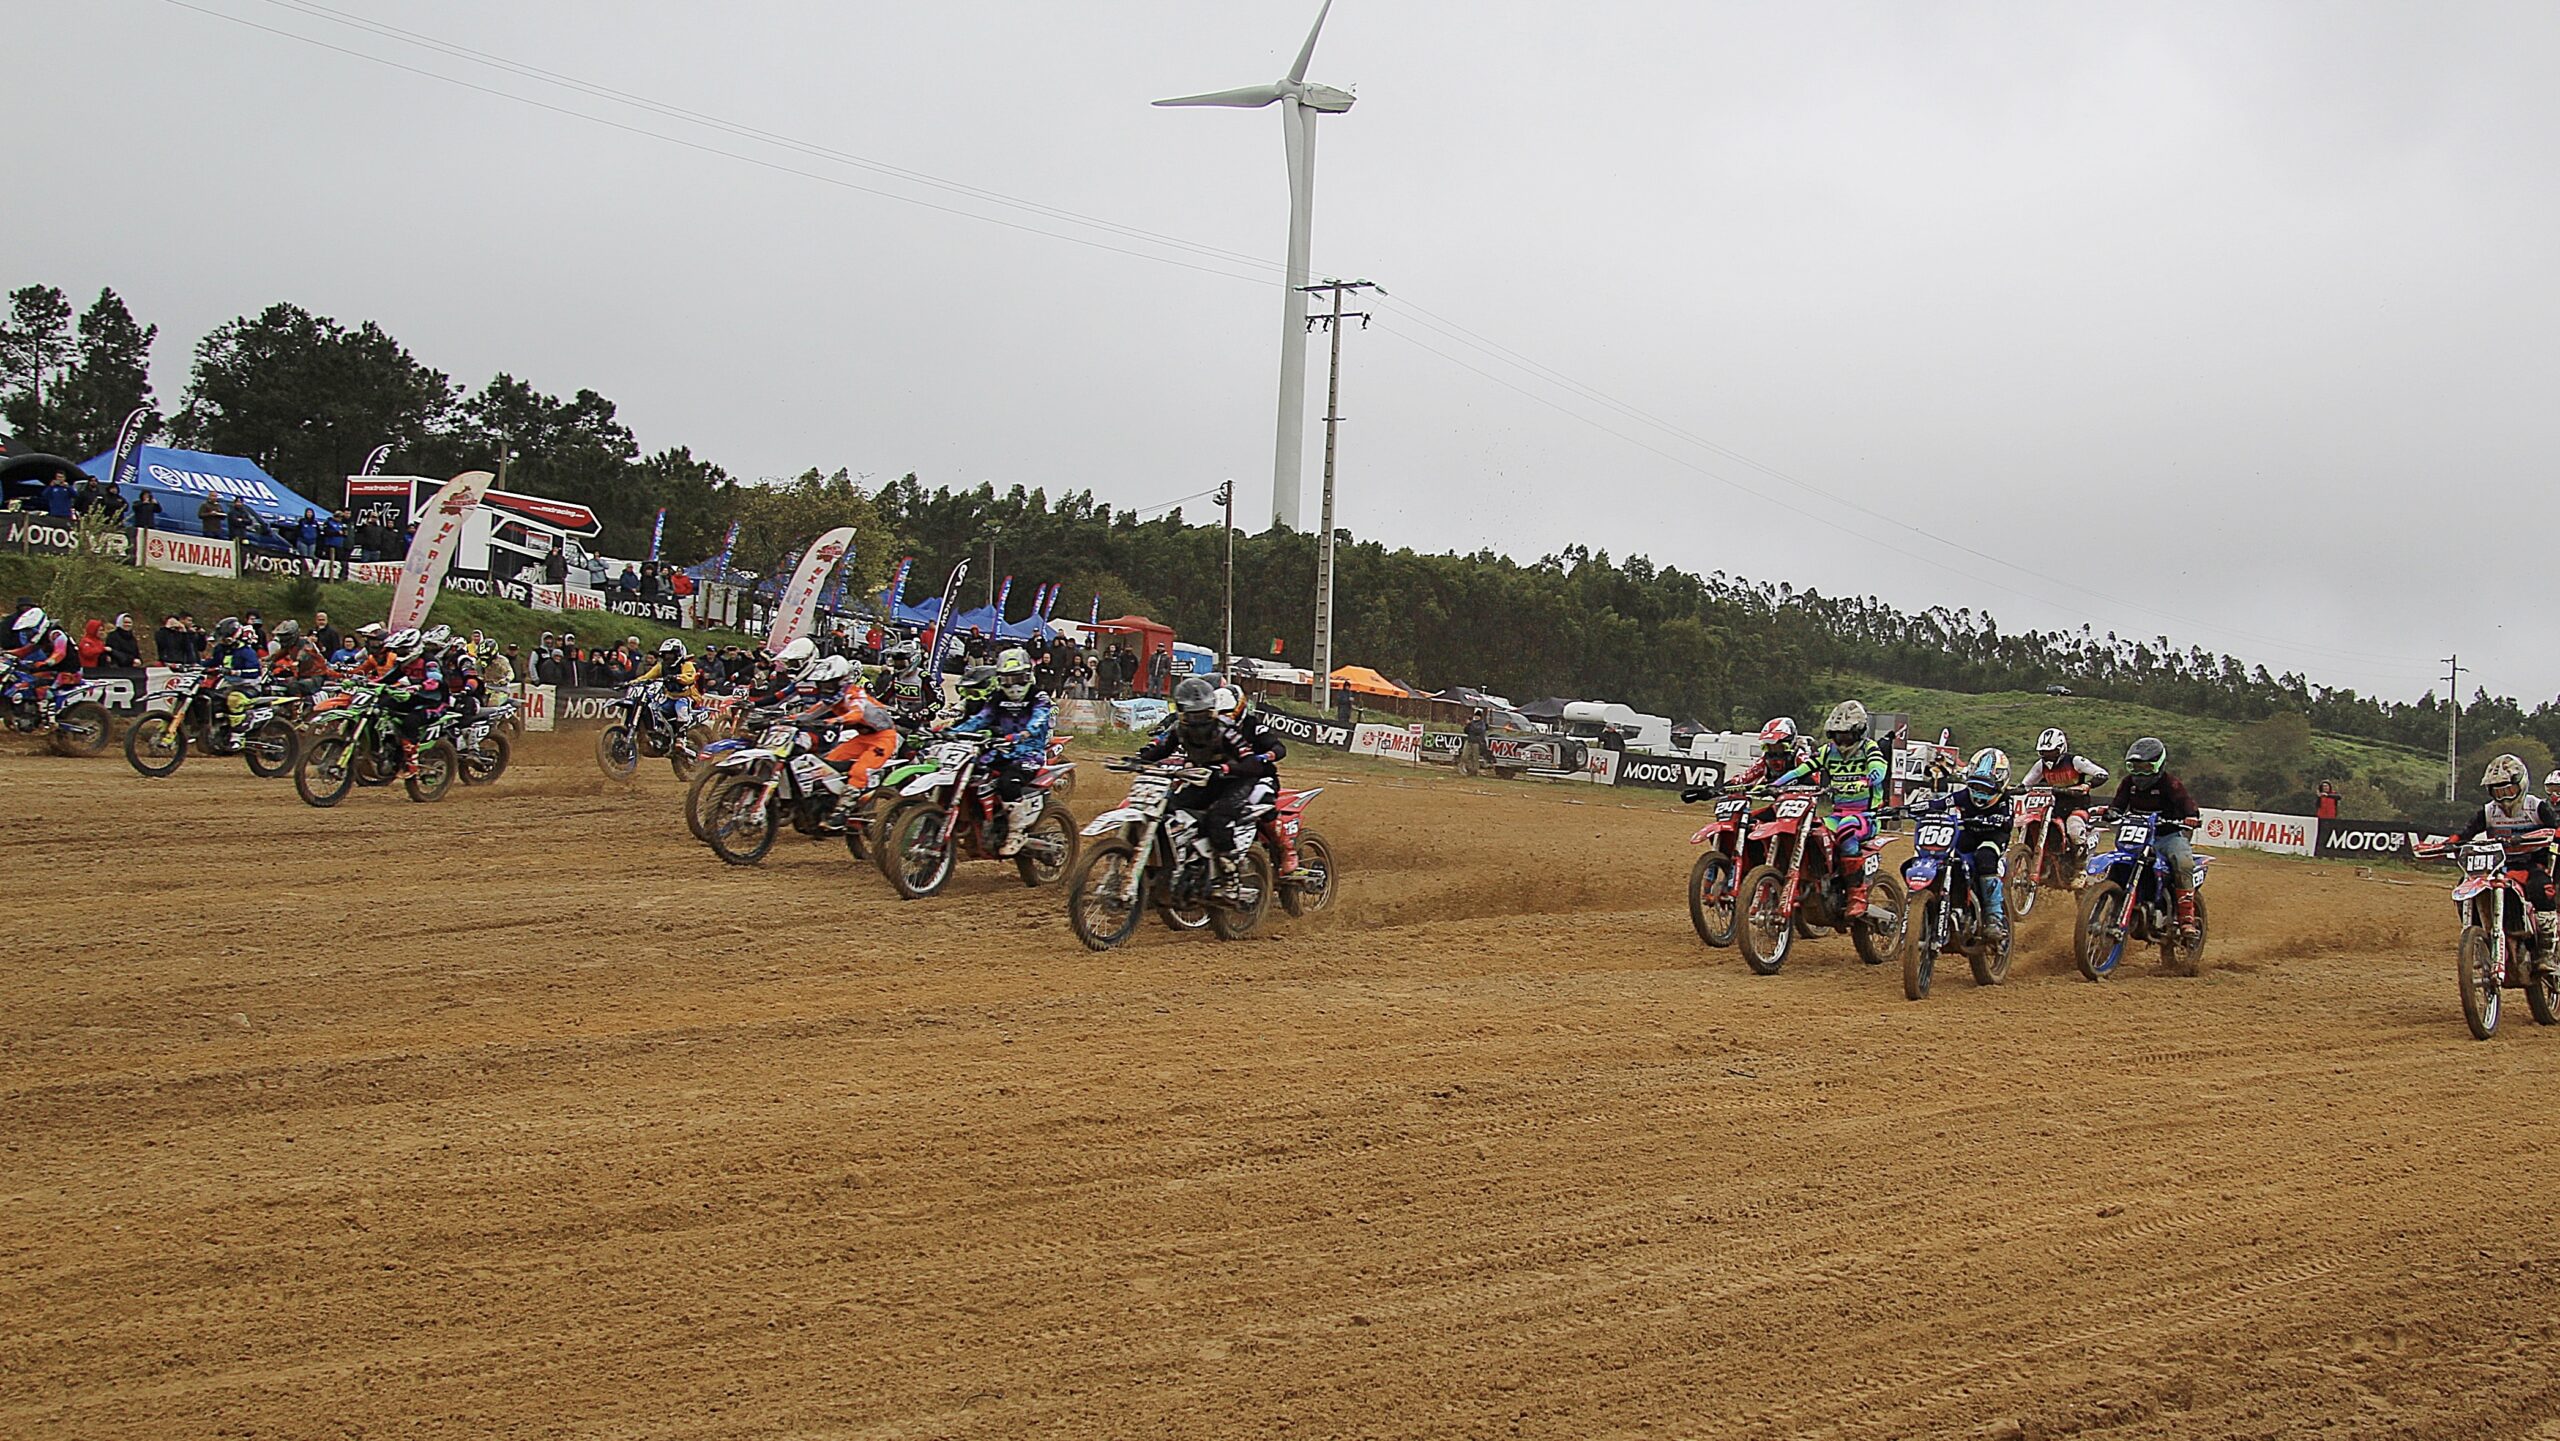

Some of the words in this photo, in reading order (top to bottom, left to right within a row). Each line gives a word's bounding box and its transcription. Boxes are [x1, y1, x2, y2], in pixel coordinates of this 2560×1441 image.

[118, 431, 138, 460] MOTOS
[136, 410, 149, 430] VR
[172, 469, 279, 501] YAMAHA
[7, 522, 80, 550] MOTOS
[433, 522, 454, 545] MX
[167, 540, 233, 570] YAMAHA
[243, 552, 301, 577] MOTOS
[408, 549, 440, 629] RIBATE
[496, 579, 528, 602] VR
[653, 603, 679, 621] VR
[1262, 713, 1313, 738] MOTOS
[1315, 723, 1349, 746] VR
[1684, 765, 1719, 787] VR
[1714, 800, 1747, 815] 247
[1776, 800, 1810, 818] 69
[1917, 825, 1955, 847] 158
[2118, 825, 2149, 844] 139
[2228, 819, 2305, 847] YAMAHA
[1864, 854, 1880, 876] 69
